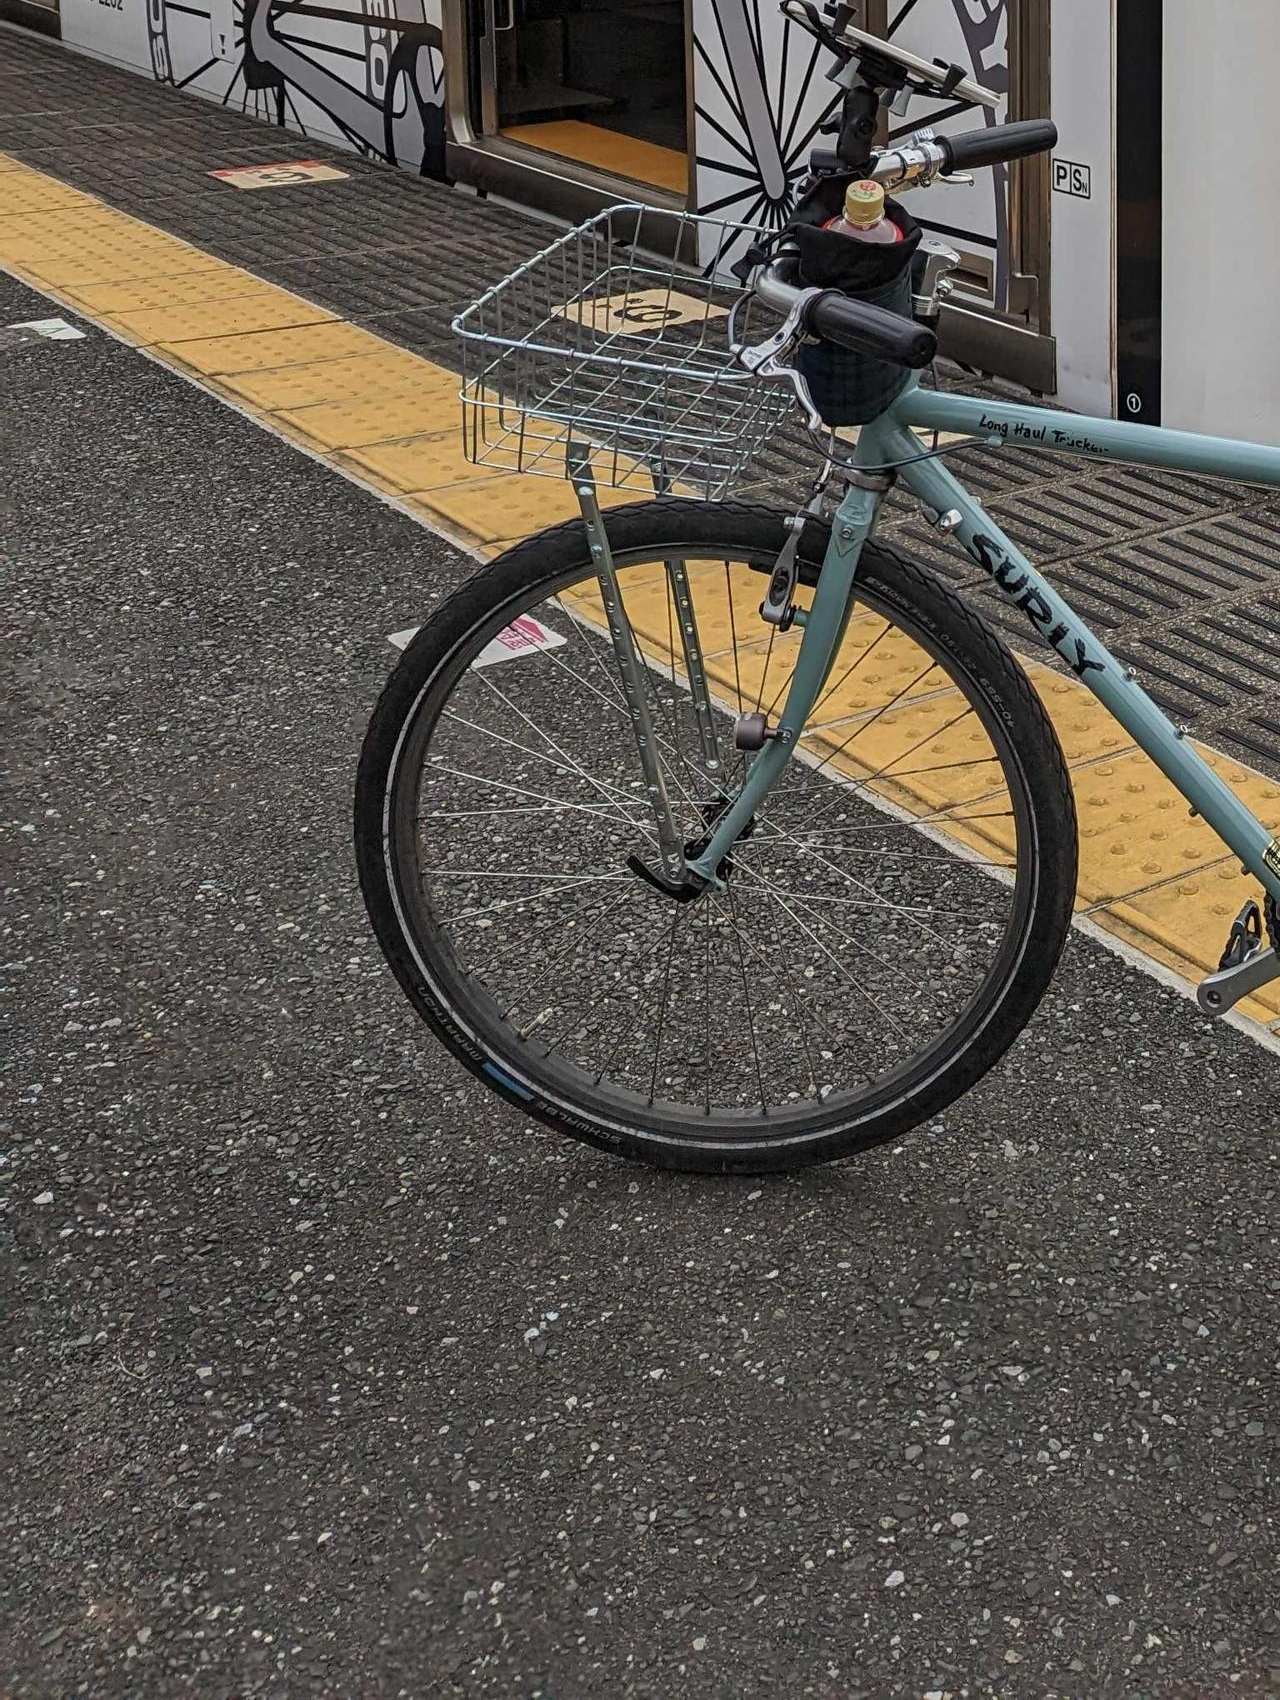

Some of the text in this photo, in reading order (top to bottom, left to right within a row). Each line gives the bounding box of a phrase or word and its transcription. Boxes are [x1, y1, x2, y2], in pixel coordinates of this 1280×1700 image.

[979, 413, 1009, 438] Long
[1014, 422, 1047, 441] Haul
[965, 532, 1106, 676] SURLY
[416, 986, 483, 1062] MARATHON
[537, 1100, 623, 1145] SCHWALBE
